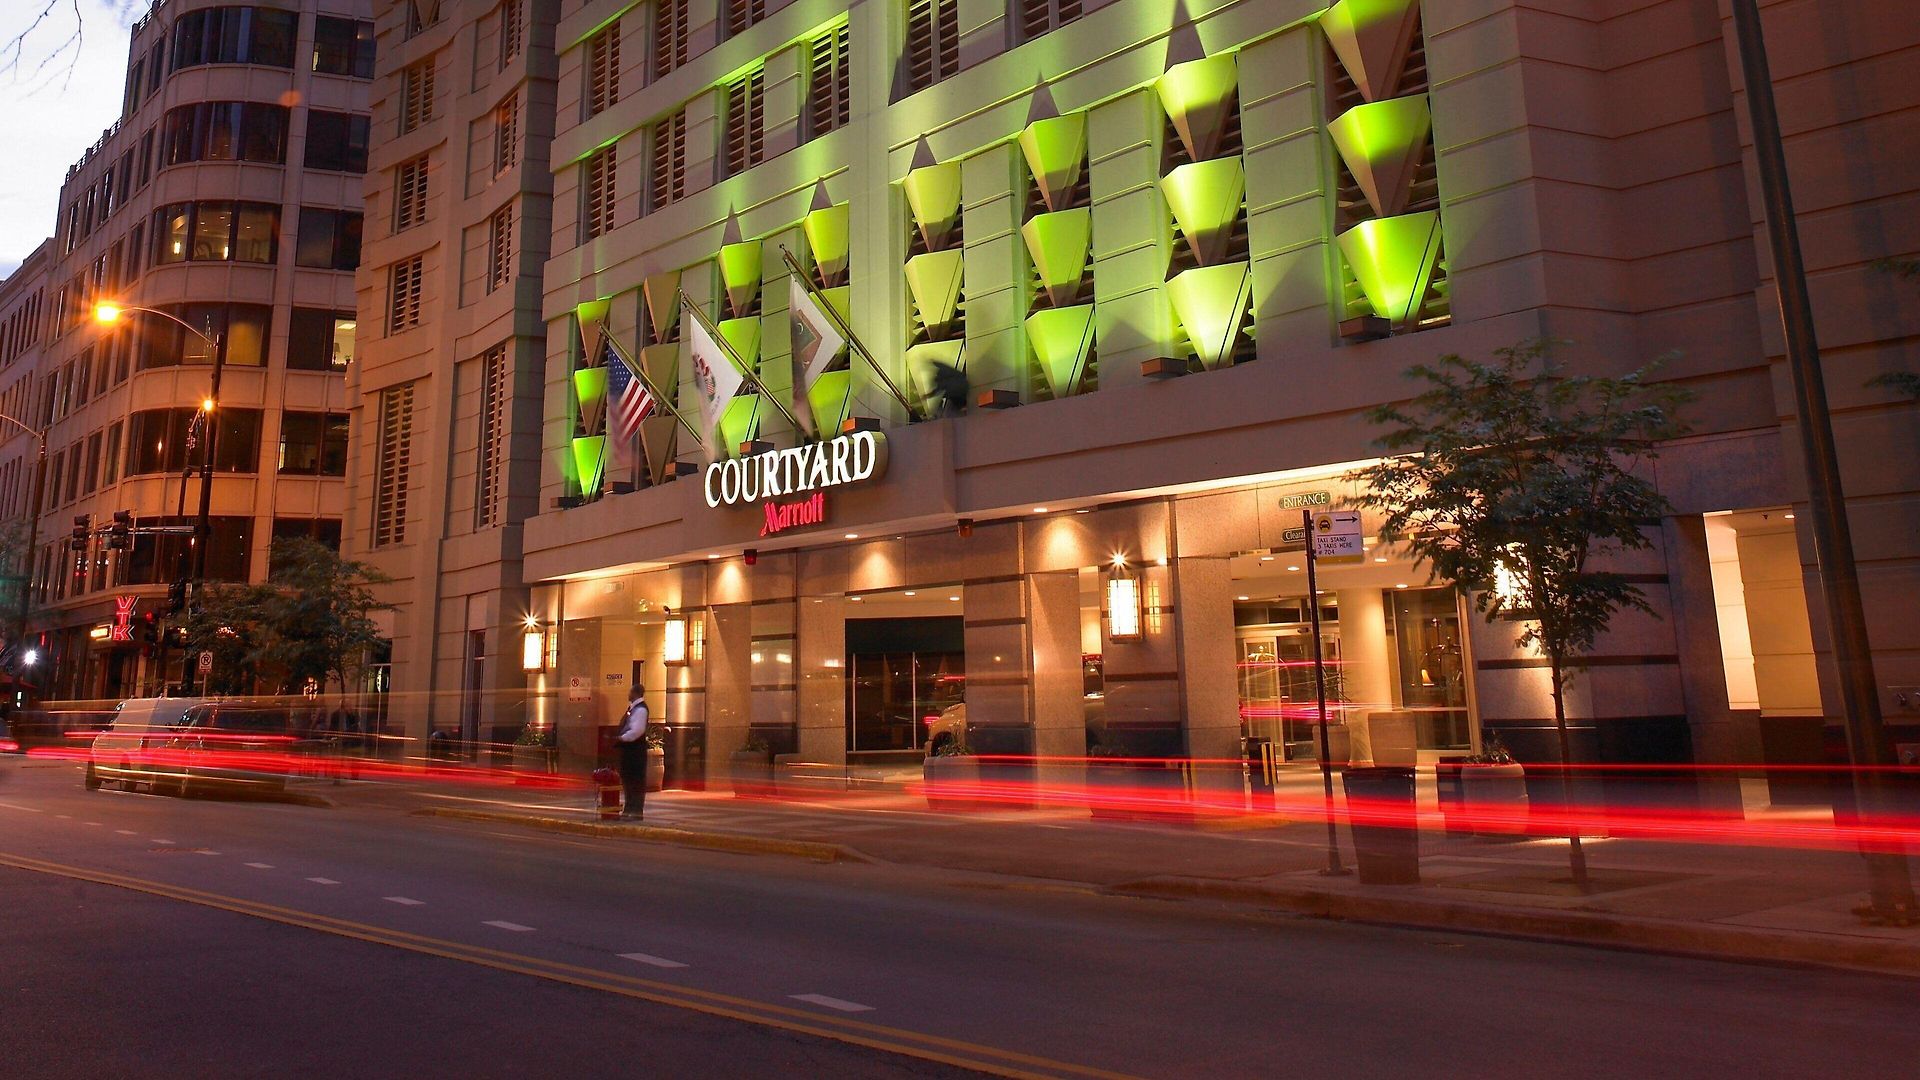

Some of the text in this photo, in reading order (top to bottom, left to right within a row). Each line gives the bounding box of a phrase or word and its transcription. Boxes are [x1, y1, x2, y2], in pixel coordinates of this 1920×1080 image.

[704, 430, 876, 508] COURTYARD
[760, 492, 825, 537] Marriott
[1283, 492, 1326, 508] ENTRANCE
[113, 595, 137, 641] VTK
